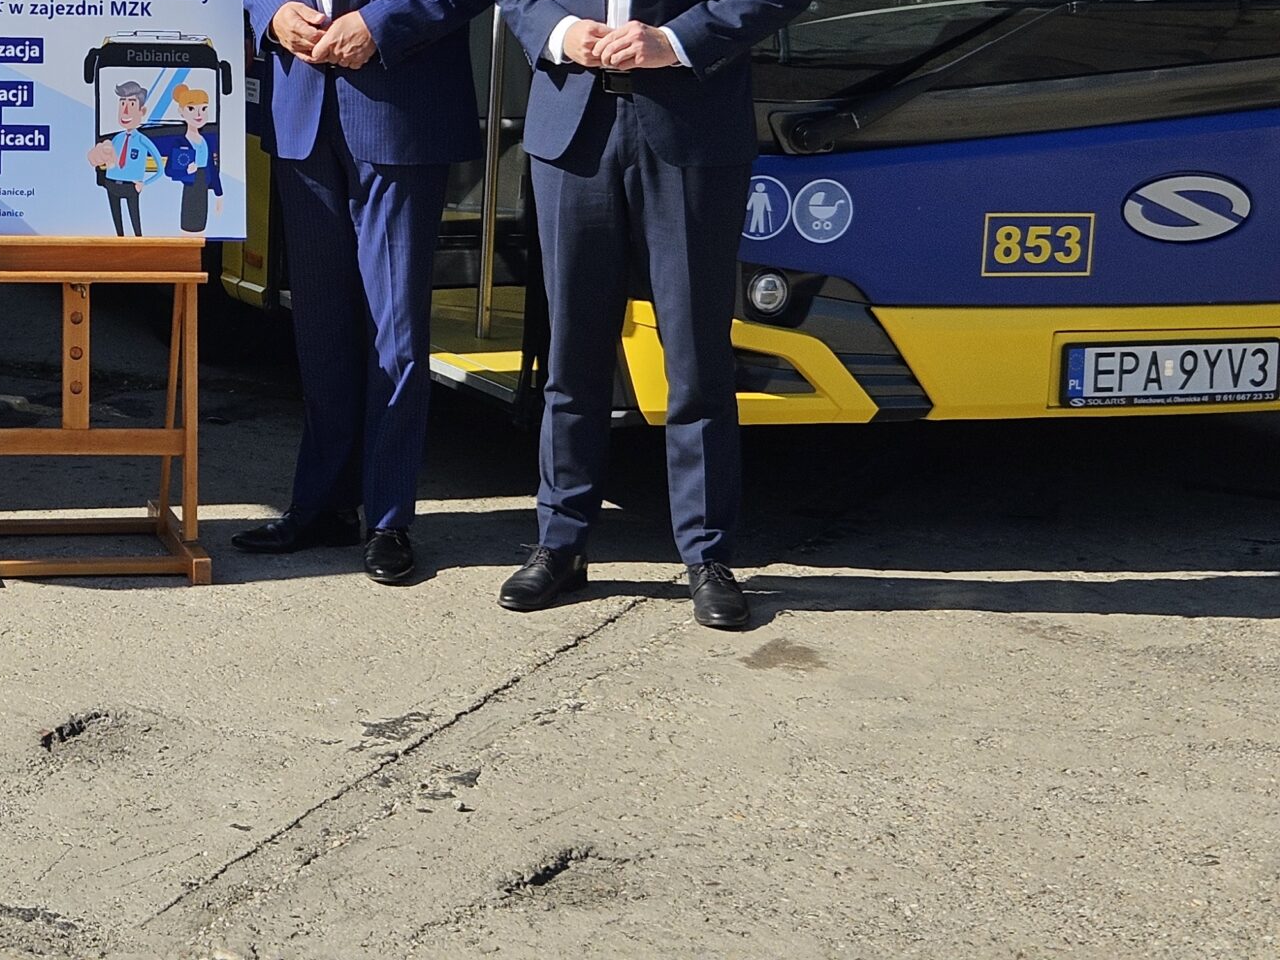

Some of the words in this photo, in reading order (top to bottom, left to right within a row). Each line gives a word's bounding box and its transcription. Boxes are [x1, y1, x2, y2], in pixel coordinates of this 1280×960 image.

[9, 3, 23, 15] w
[30, 0, 103, 19] zajezdni
[110, 2, 152, 17] MZK
[126, 48, 190, 63] Pabianice
[993, 225, 1082, 265] 853
[1093, 350, 1163, 393] EPA
[1179, 348, 1269, 391] 9YV3
[1068, 380, 1082, 390] PL
[1087, 398, 1126, 406] SOLARIS
